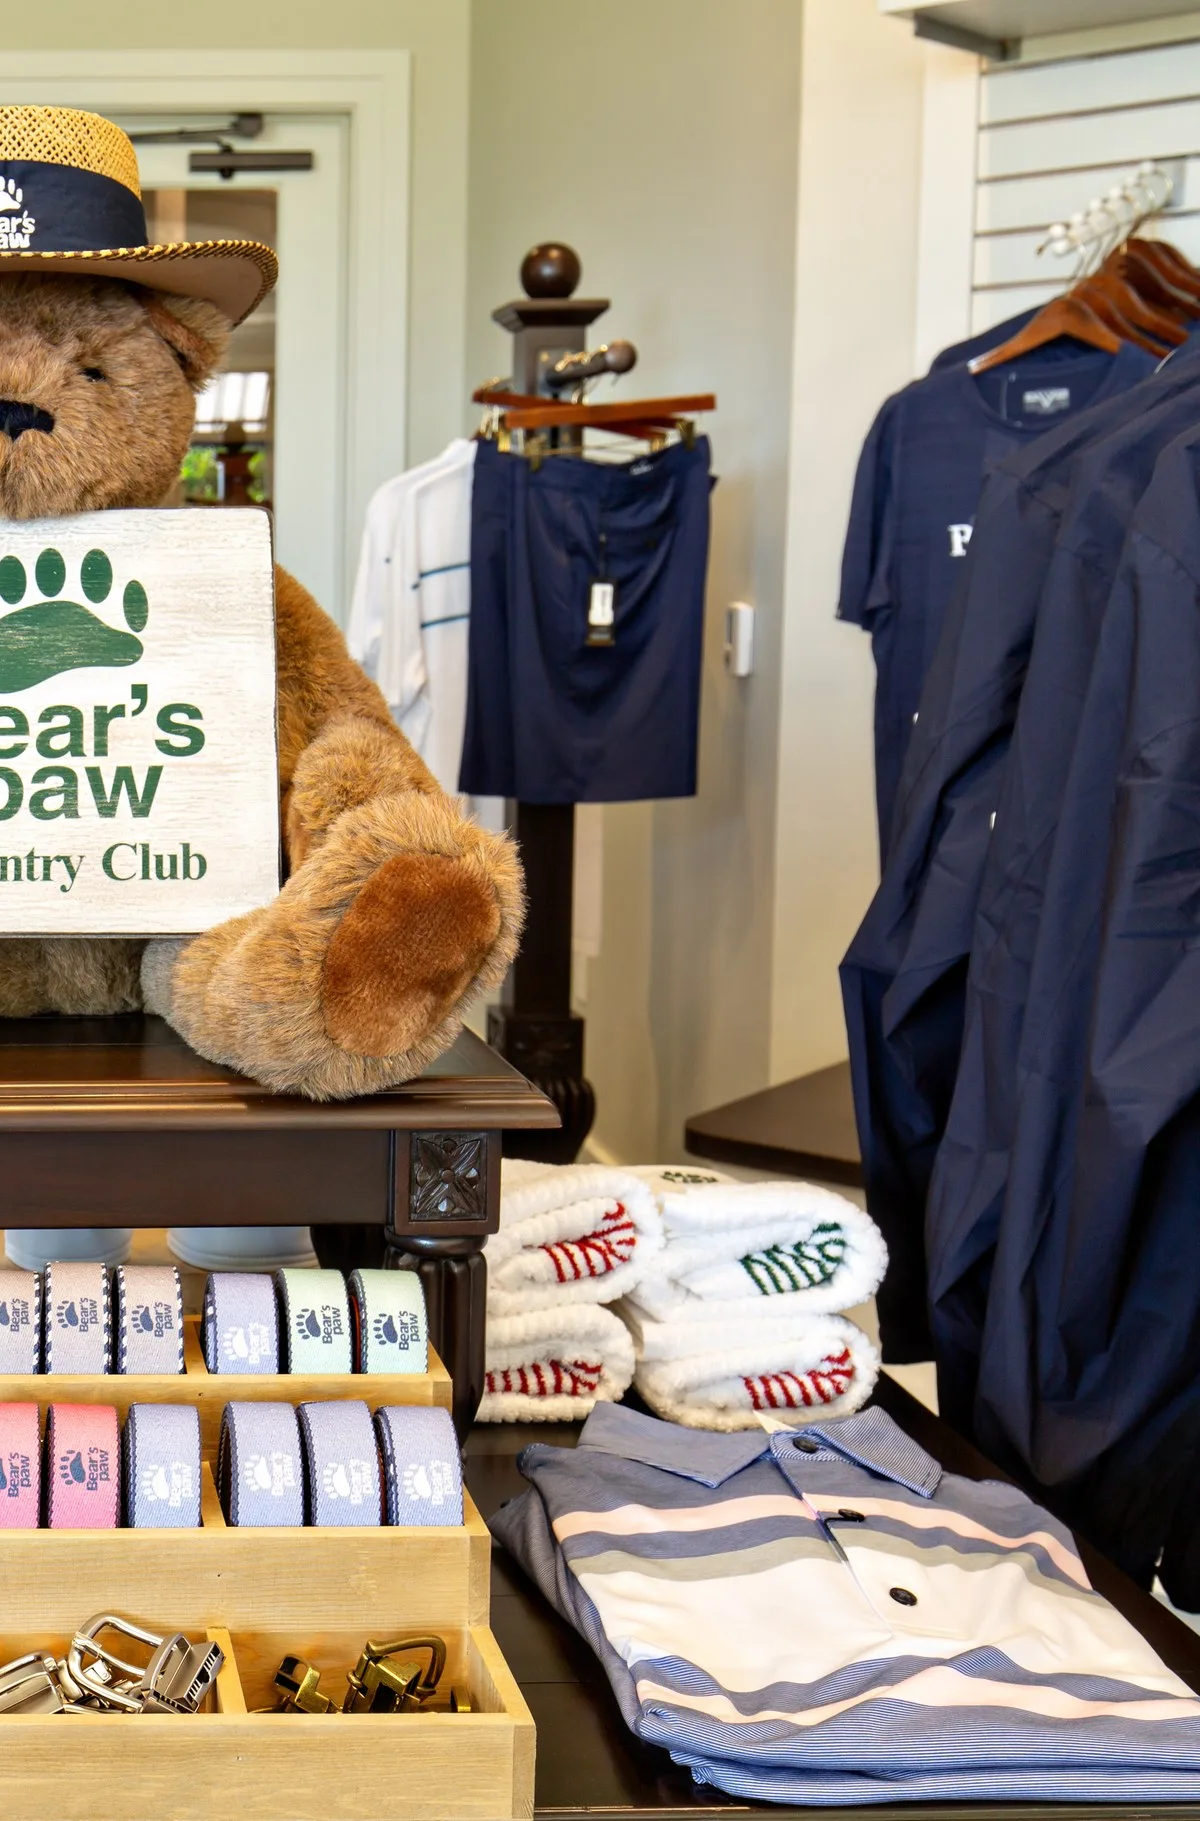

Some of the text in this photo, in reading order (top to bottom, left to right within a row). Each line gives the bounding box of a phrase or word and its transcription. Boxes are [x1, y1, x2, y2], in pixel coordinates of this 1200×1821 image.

[102, 842, 208, 882] Club
[10, 1298, 21, 1332] Bear's
[20, 1299, 31, 1325] paw
[79, 1297, 89, 1333] Bear's
[88, 1299, 99, 1324] paw
[154, 1301, 164, 1338] Bear's
[163, 1303, 175, 1330] paw
[321, 1305, 333, 1344] Bear's
[331, 1306, 344, 1335] paw
[408, 1313, 421, 1342] paw
[398, 1310, 410, 1350] Bear's
[8, 1452, 20, 1497] Bear's
[19, 1454, 31, 1488] paw
[86, 1446, 99, 1491] Bear's
[98, 1448, 110, 1482] paw
